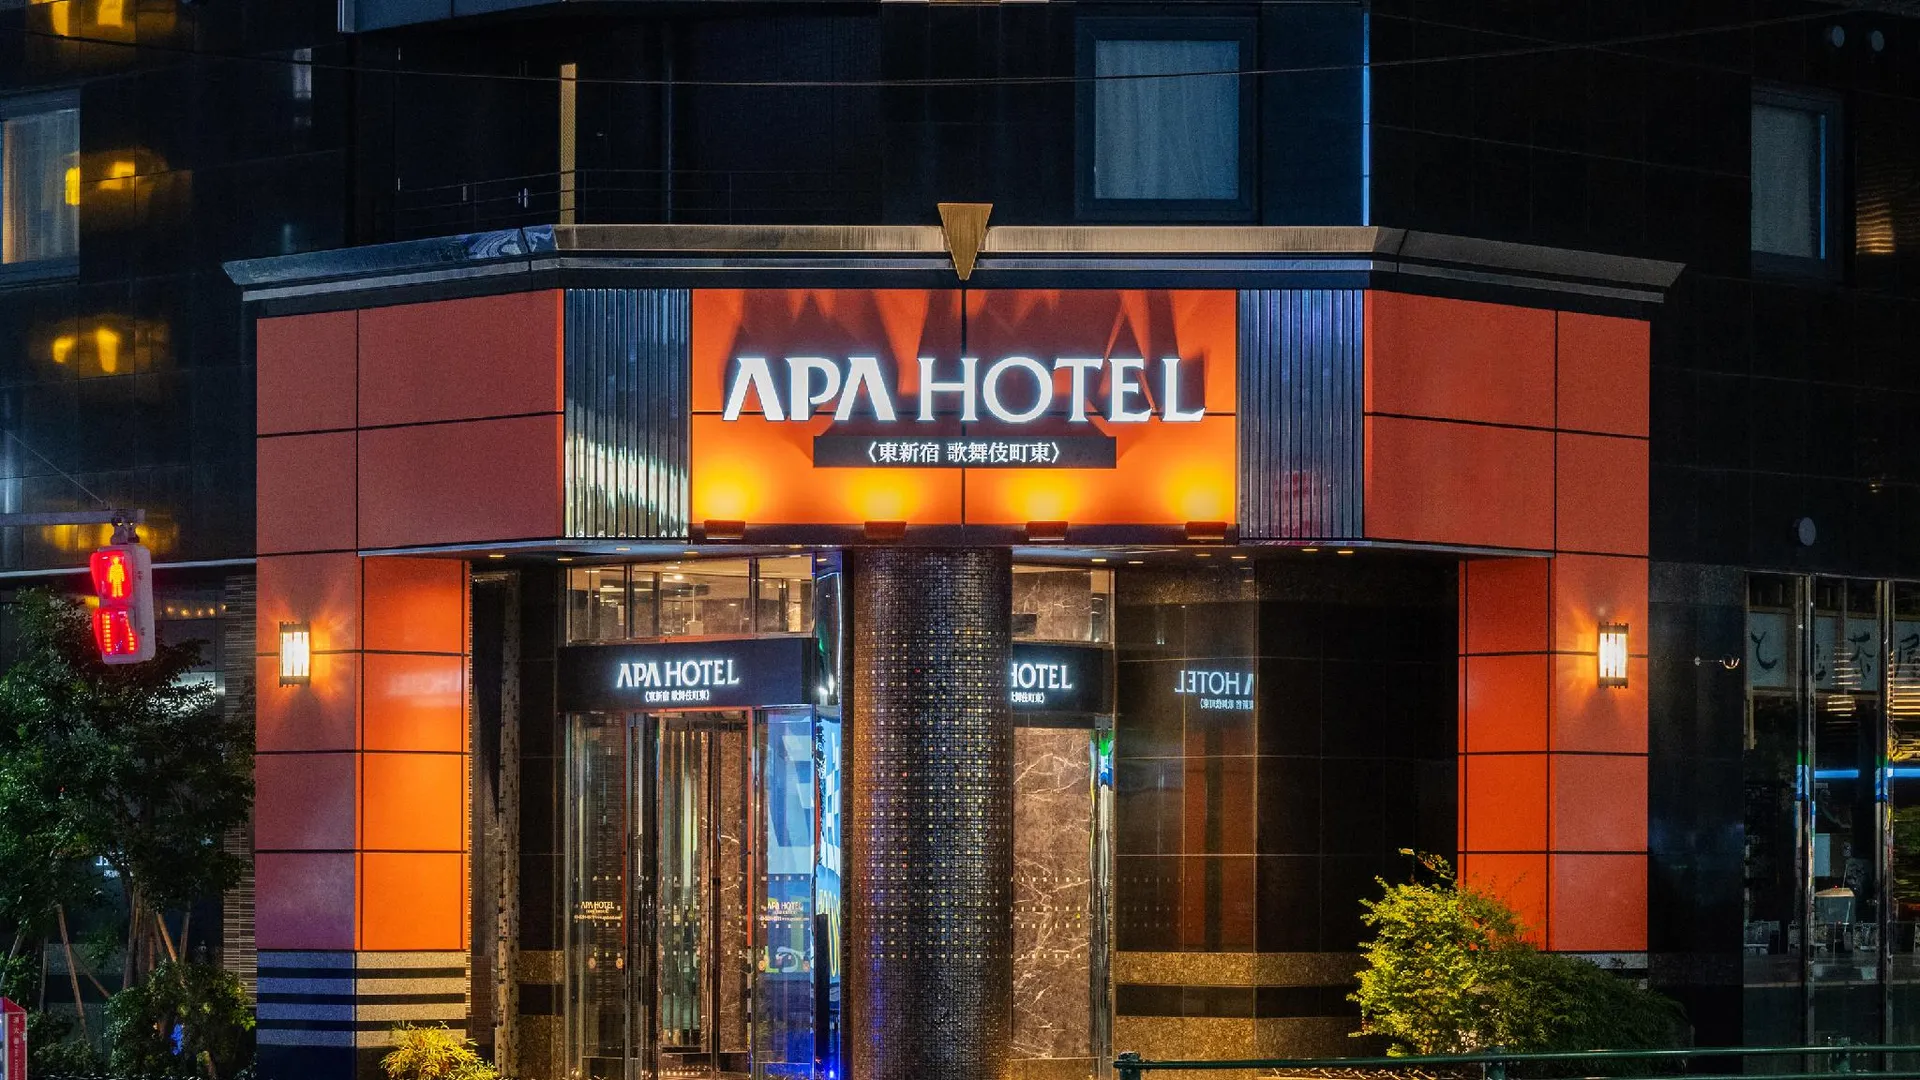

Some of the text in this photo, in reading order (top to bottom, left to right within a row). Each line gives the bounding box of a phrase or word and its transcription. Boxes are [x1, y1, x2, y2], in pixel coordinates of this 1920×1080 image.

[723, 356, 1205, 422] APA HOTEL
[617, 660, 740, 688] APA HOTEL
[594, 901, 614, 909] HOTEL
